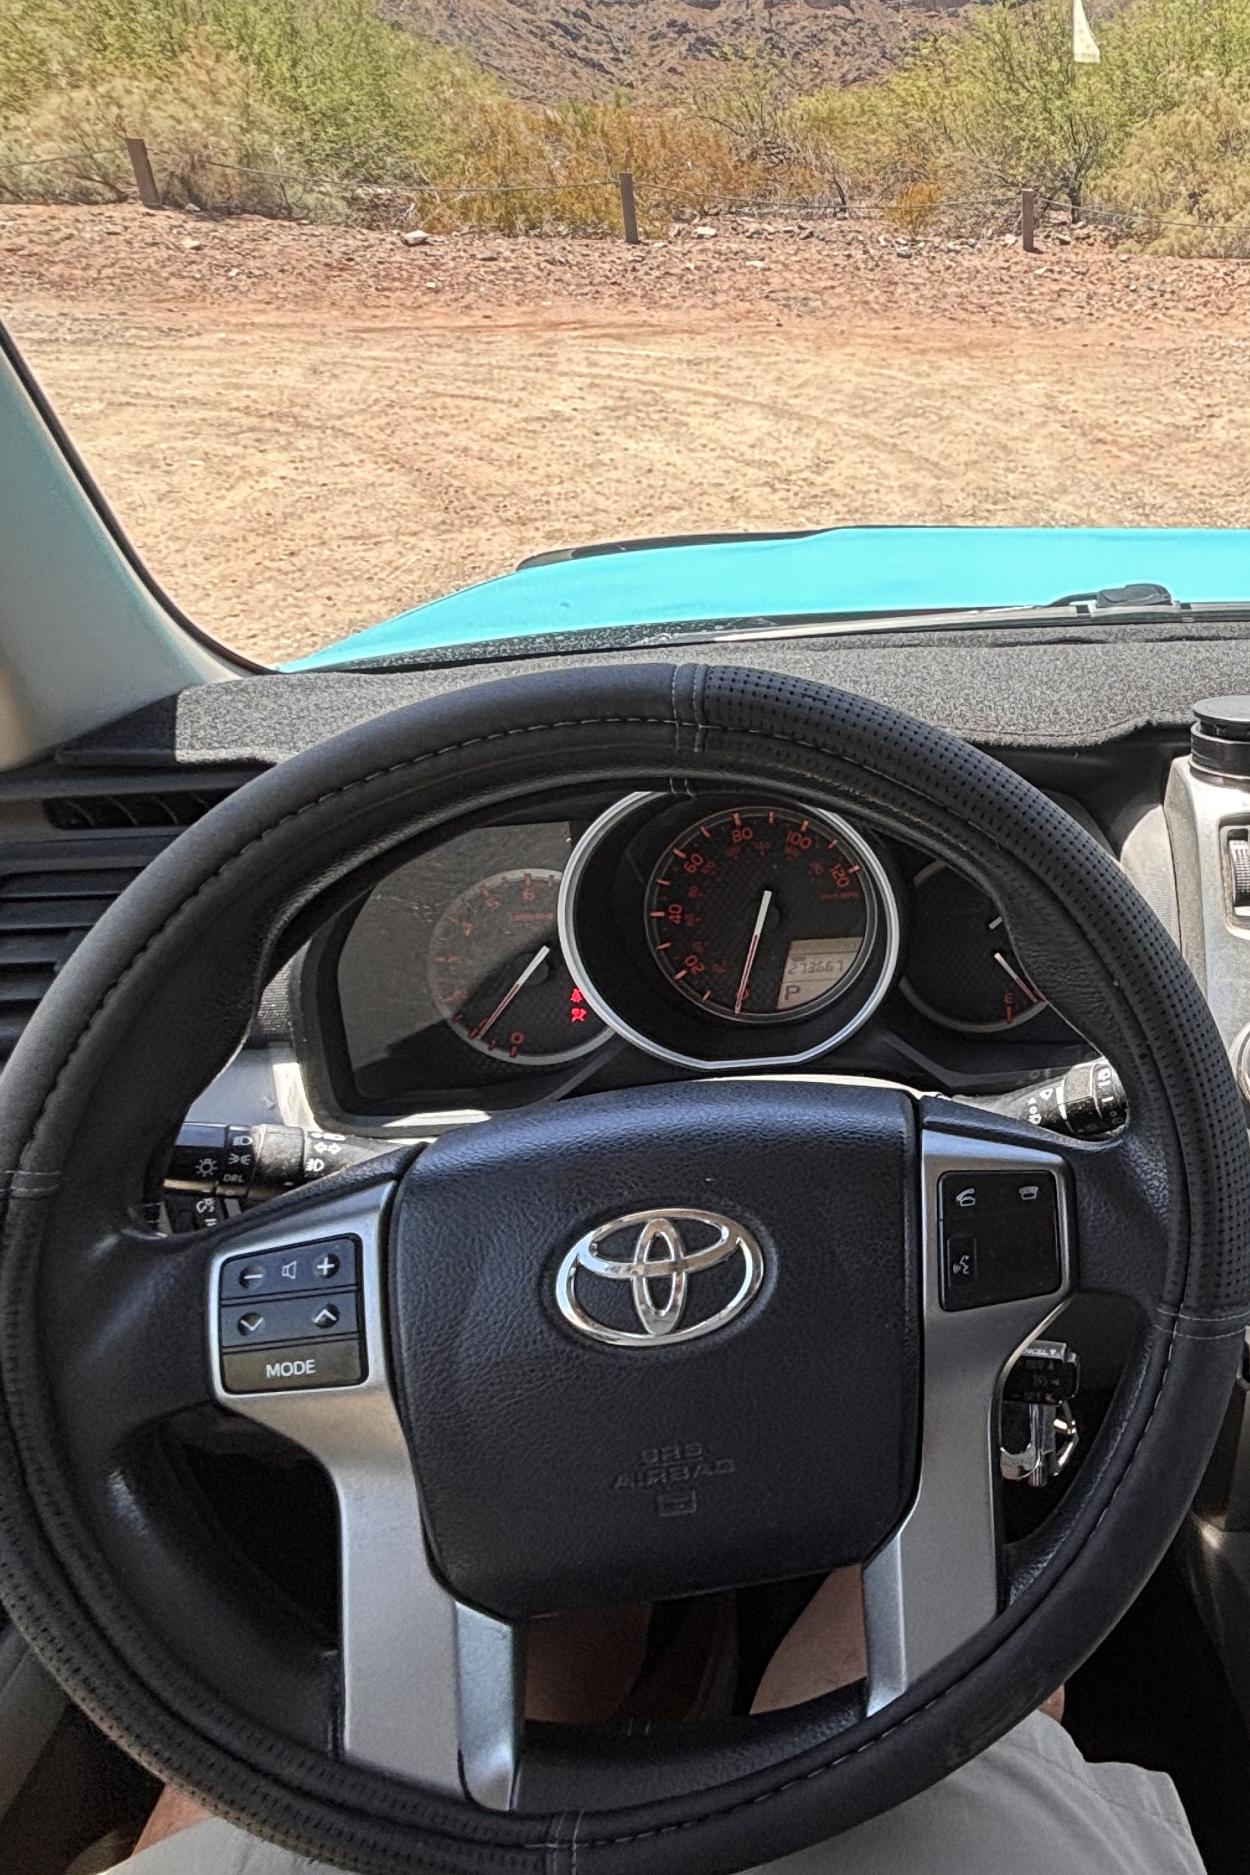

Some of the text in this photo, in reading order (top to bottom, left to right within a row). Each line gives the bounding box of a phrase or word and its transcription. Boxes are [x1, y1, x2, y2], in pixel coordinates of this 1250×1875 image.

[731, 827, 753, 843] 80
[786, 831, 812, 849] 100
[684, 854, 704, 873] 60
[829, 863, 850, 888] 120
[668, 903, 682, 925] 40
[684, 954, 705, 976] 20
[784, 984, 801, 1001] P
[222, 1172, 246, 1184] DRL
[265, 1358, 317, 1379] MODE
[611, 1458, 735, 1490] AIRBAG
